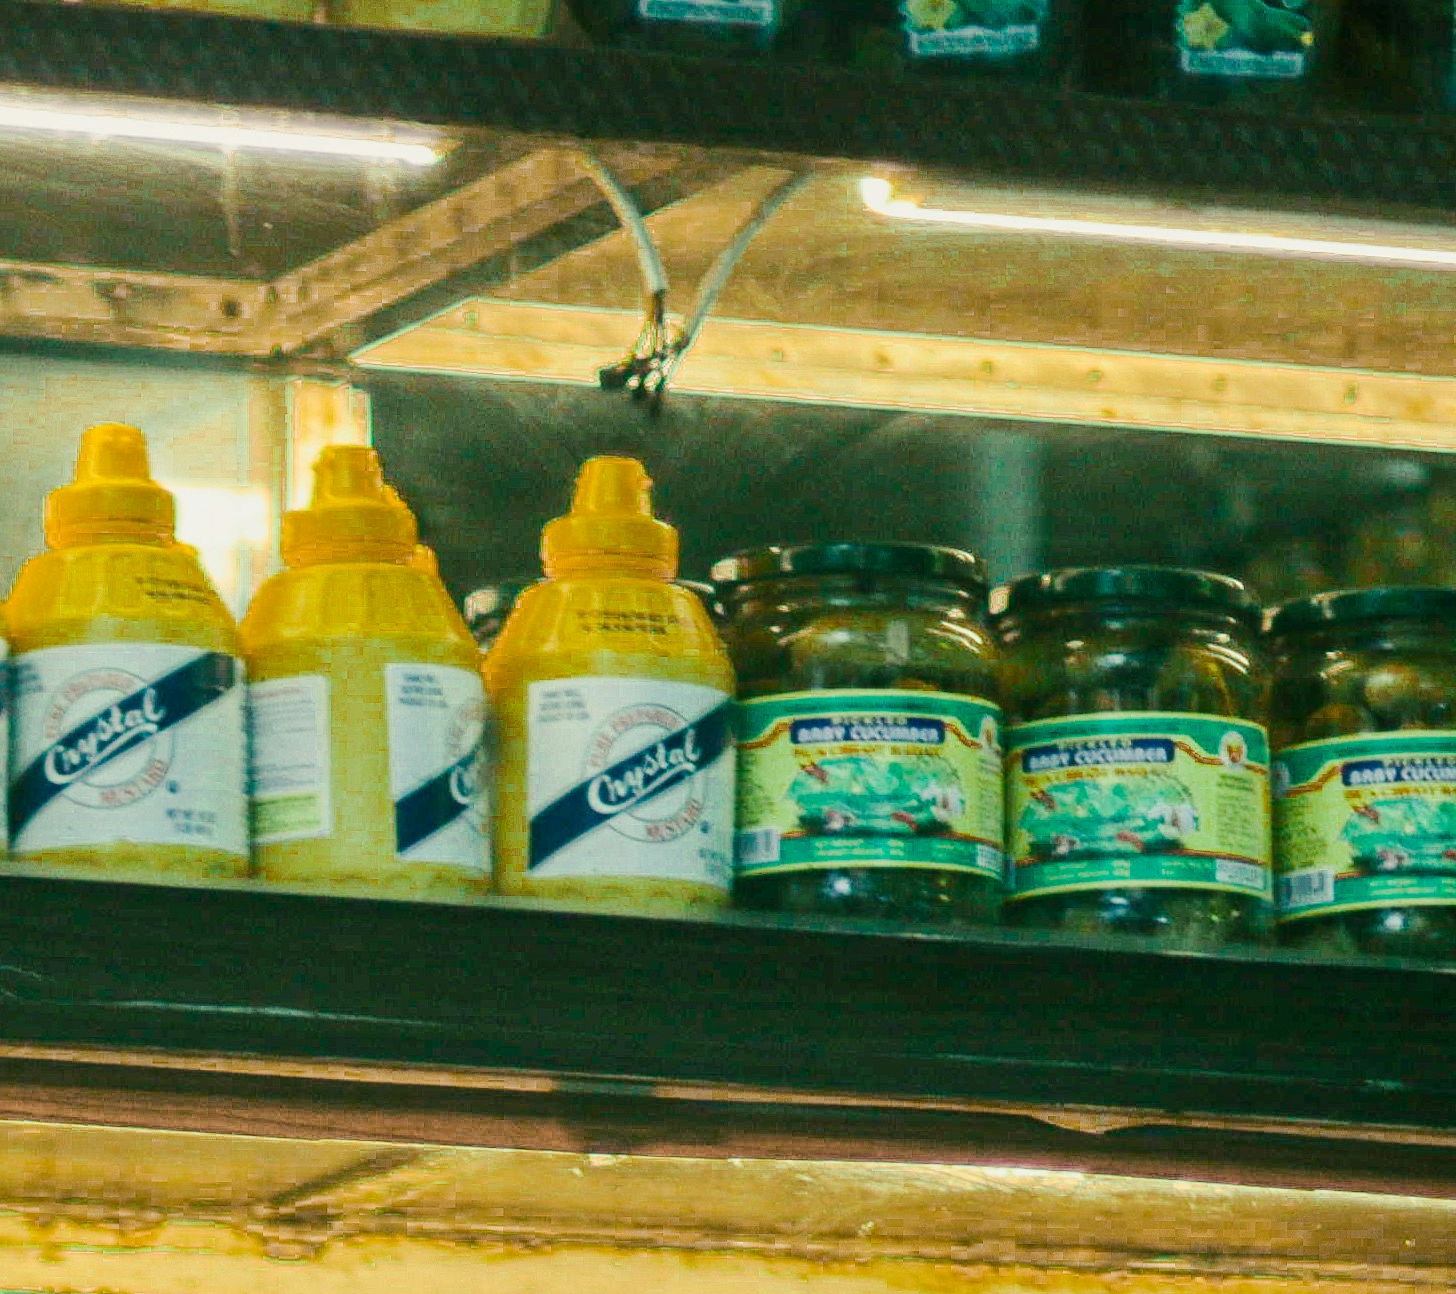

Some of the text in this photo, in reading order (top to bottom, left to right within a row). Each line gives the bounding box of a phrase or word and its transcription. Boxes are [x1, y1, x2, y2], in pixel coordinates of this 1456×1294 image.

[44, 687, 167, 785] Crystal
[849, 725, 940, 743] CUCUMBER
[1074, 746, 1168, 766] CUCUMBER
[587, 728, 702, 815] Crystal
